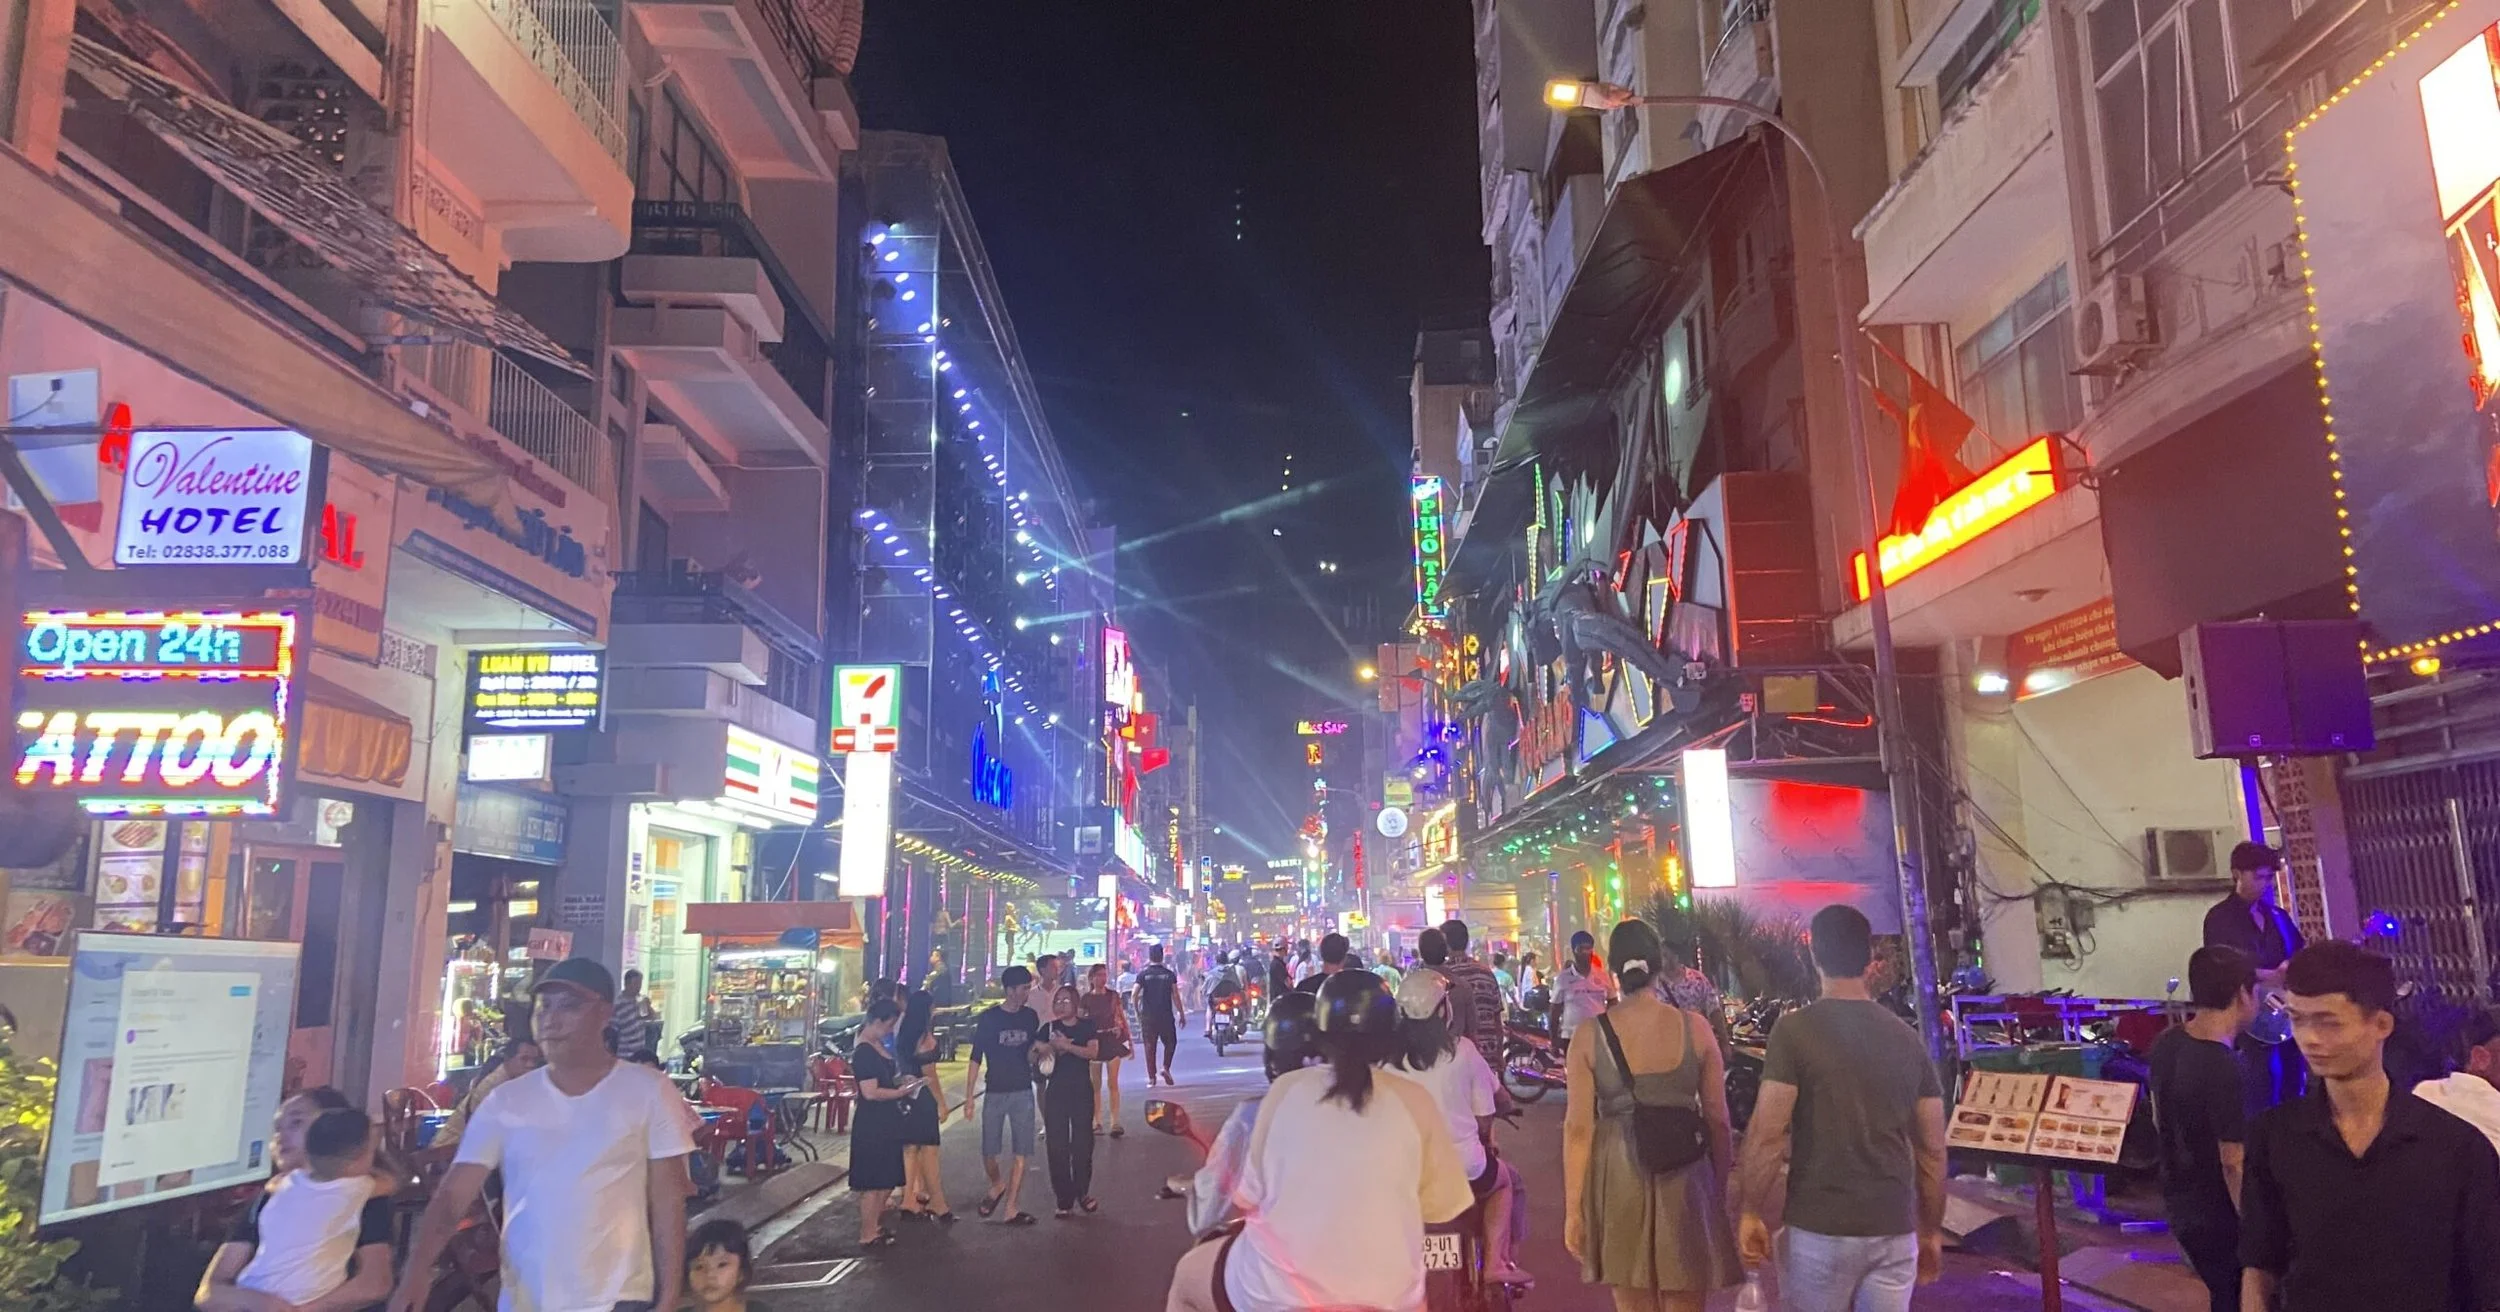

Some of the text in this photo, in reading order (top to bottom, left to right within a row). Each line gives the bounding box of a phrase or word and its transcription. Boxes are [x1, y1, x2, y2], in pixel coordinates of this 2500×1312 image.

[133, 436, 301, 499] Valentine
[140, 506, 283, 535] HOTEL
[127, 544, 289, 559] Tel: 02838.377.088
[27, 623, 241, 669] Open 24h
